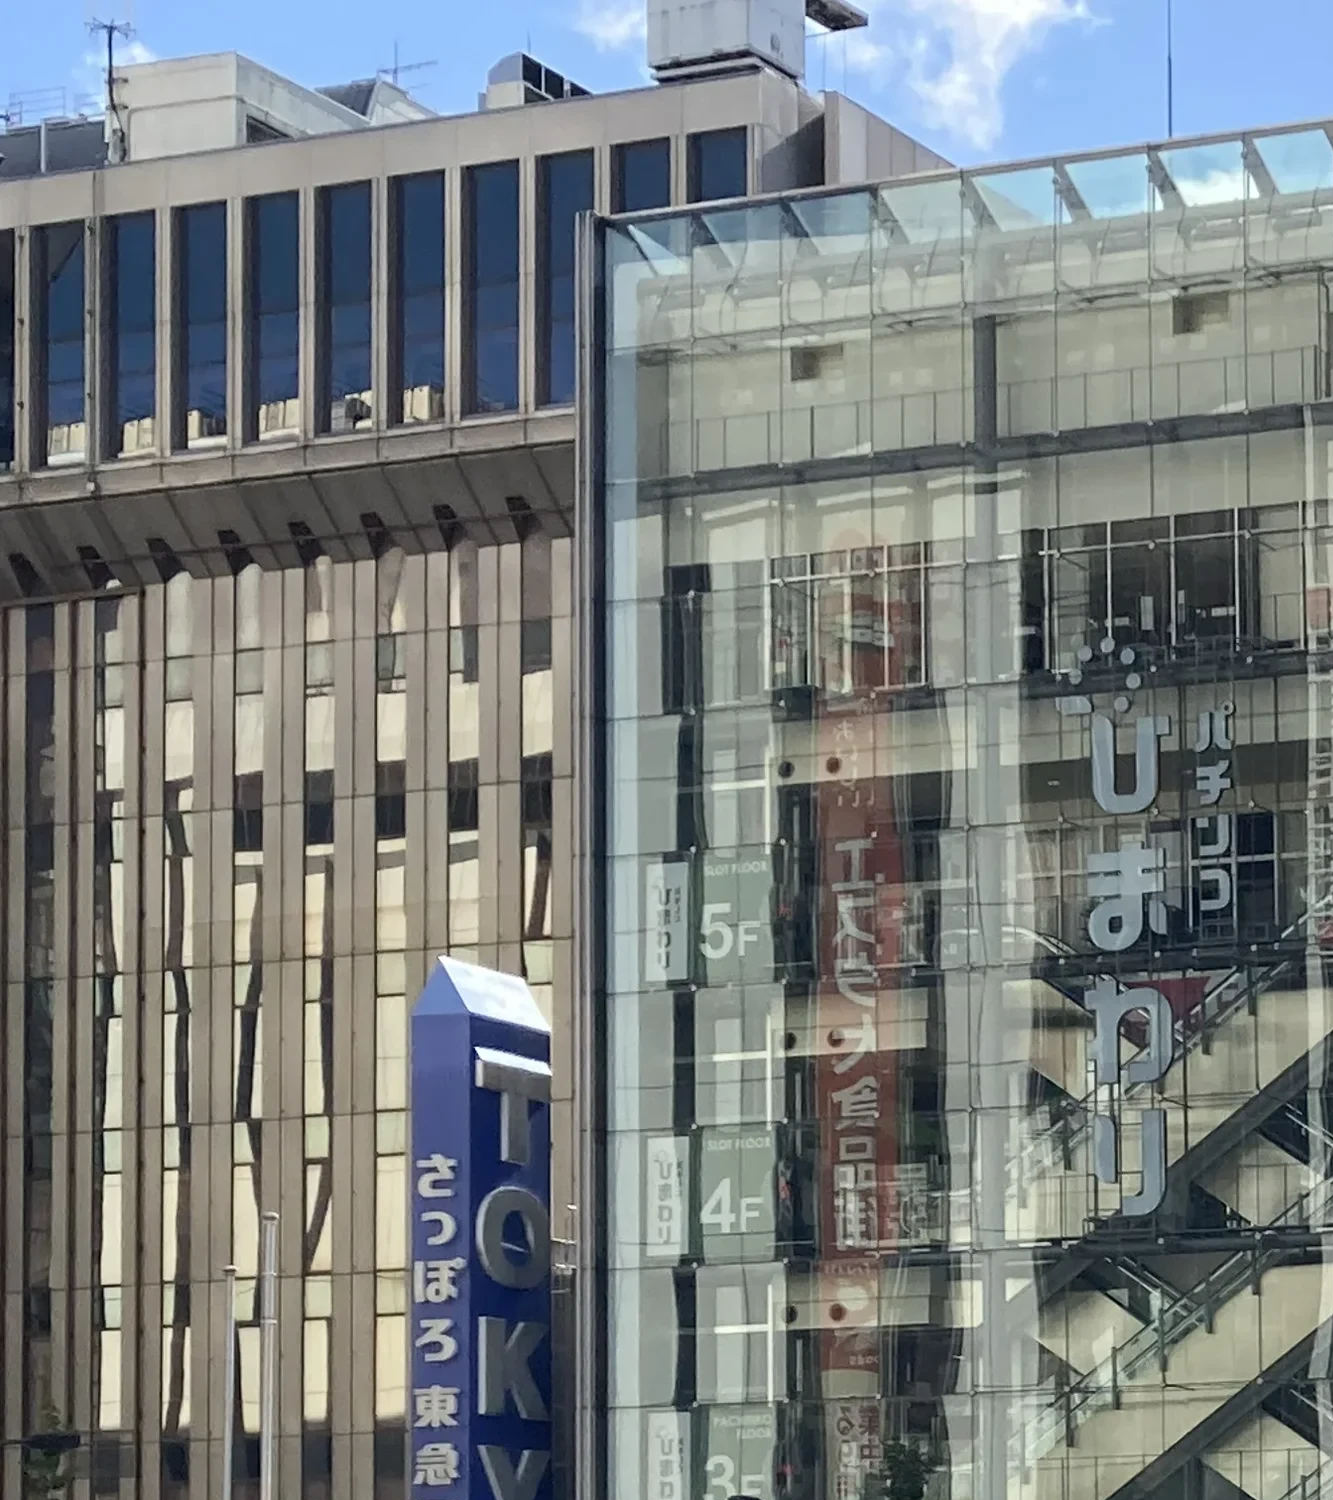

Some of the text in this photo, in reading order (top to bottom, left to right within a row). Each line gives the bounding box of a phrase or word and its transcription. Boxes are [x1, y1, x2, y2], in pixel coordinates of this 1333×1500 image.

[1191, 699, 1237, 913] パチンコ
[699, 901, 761, 960] 5F
[1056, 694, 1175, 1217] ひまわり
[699, 1176, 764, 1234] 4F
